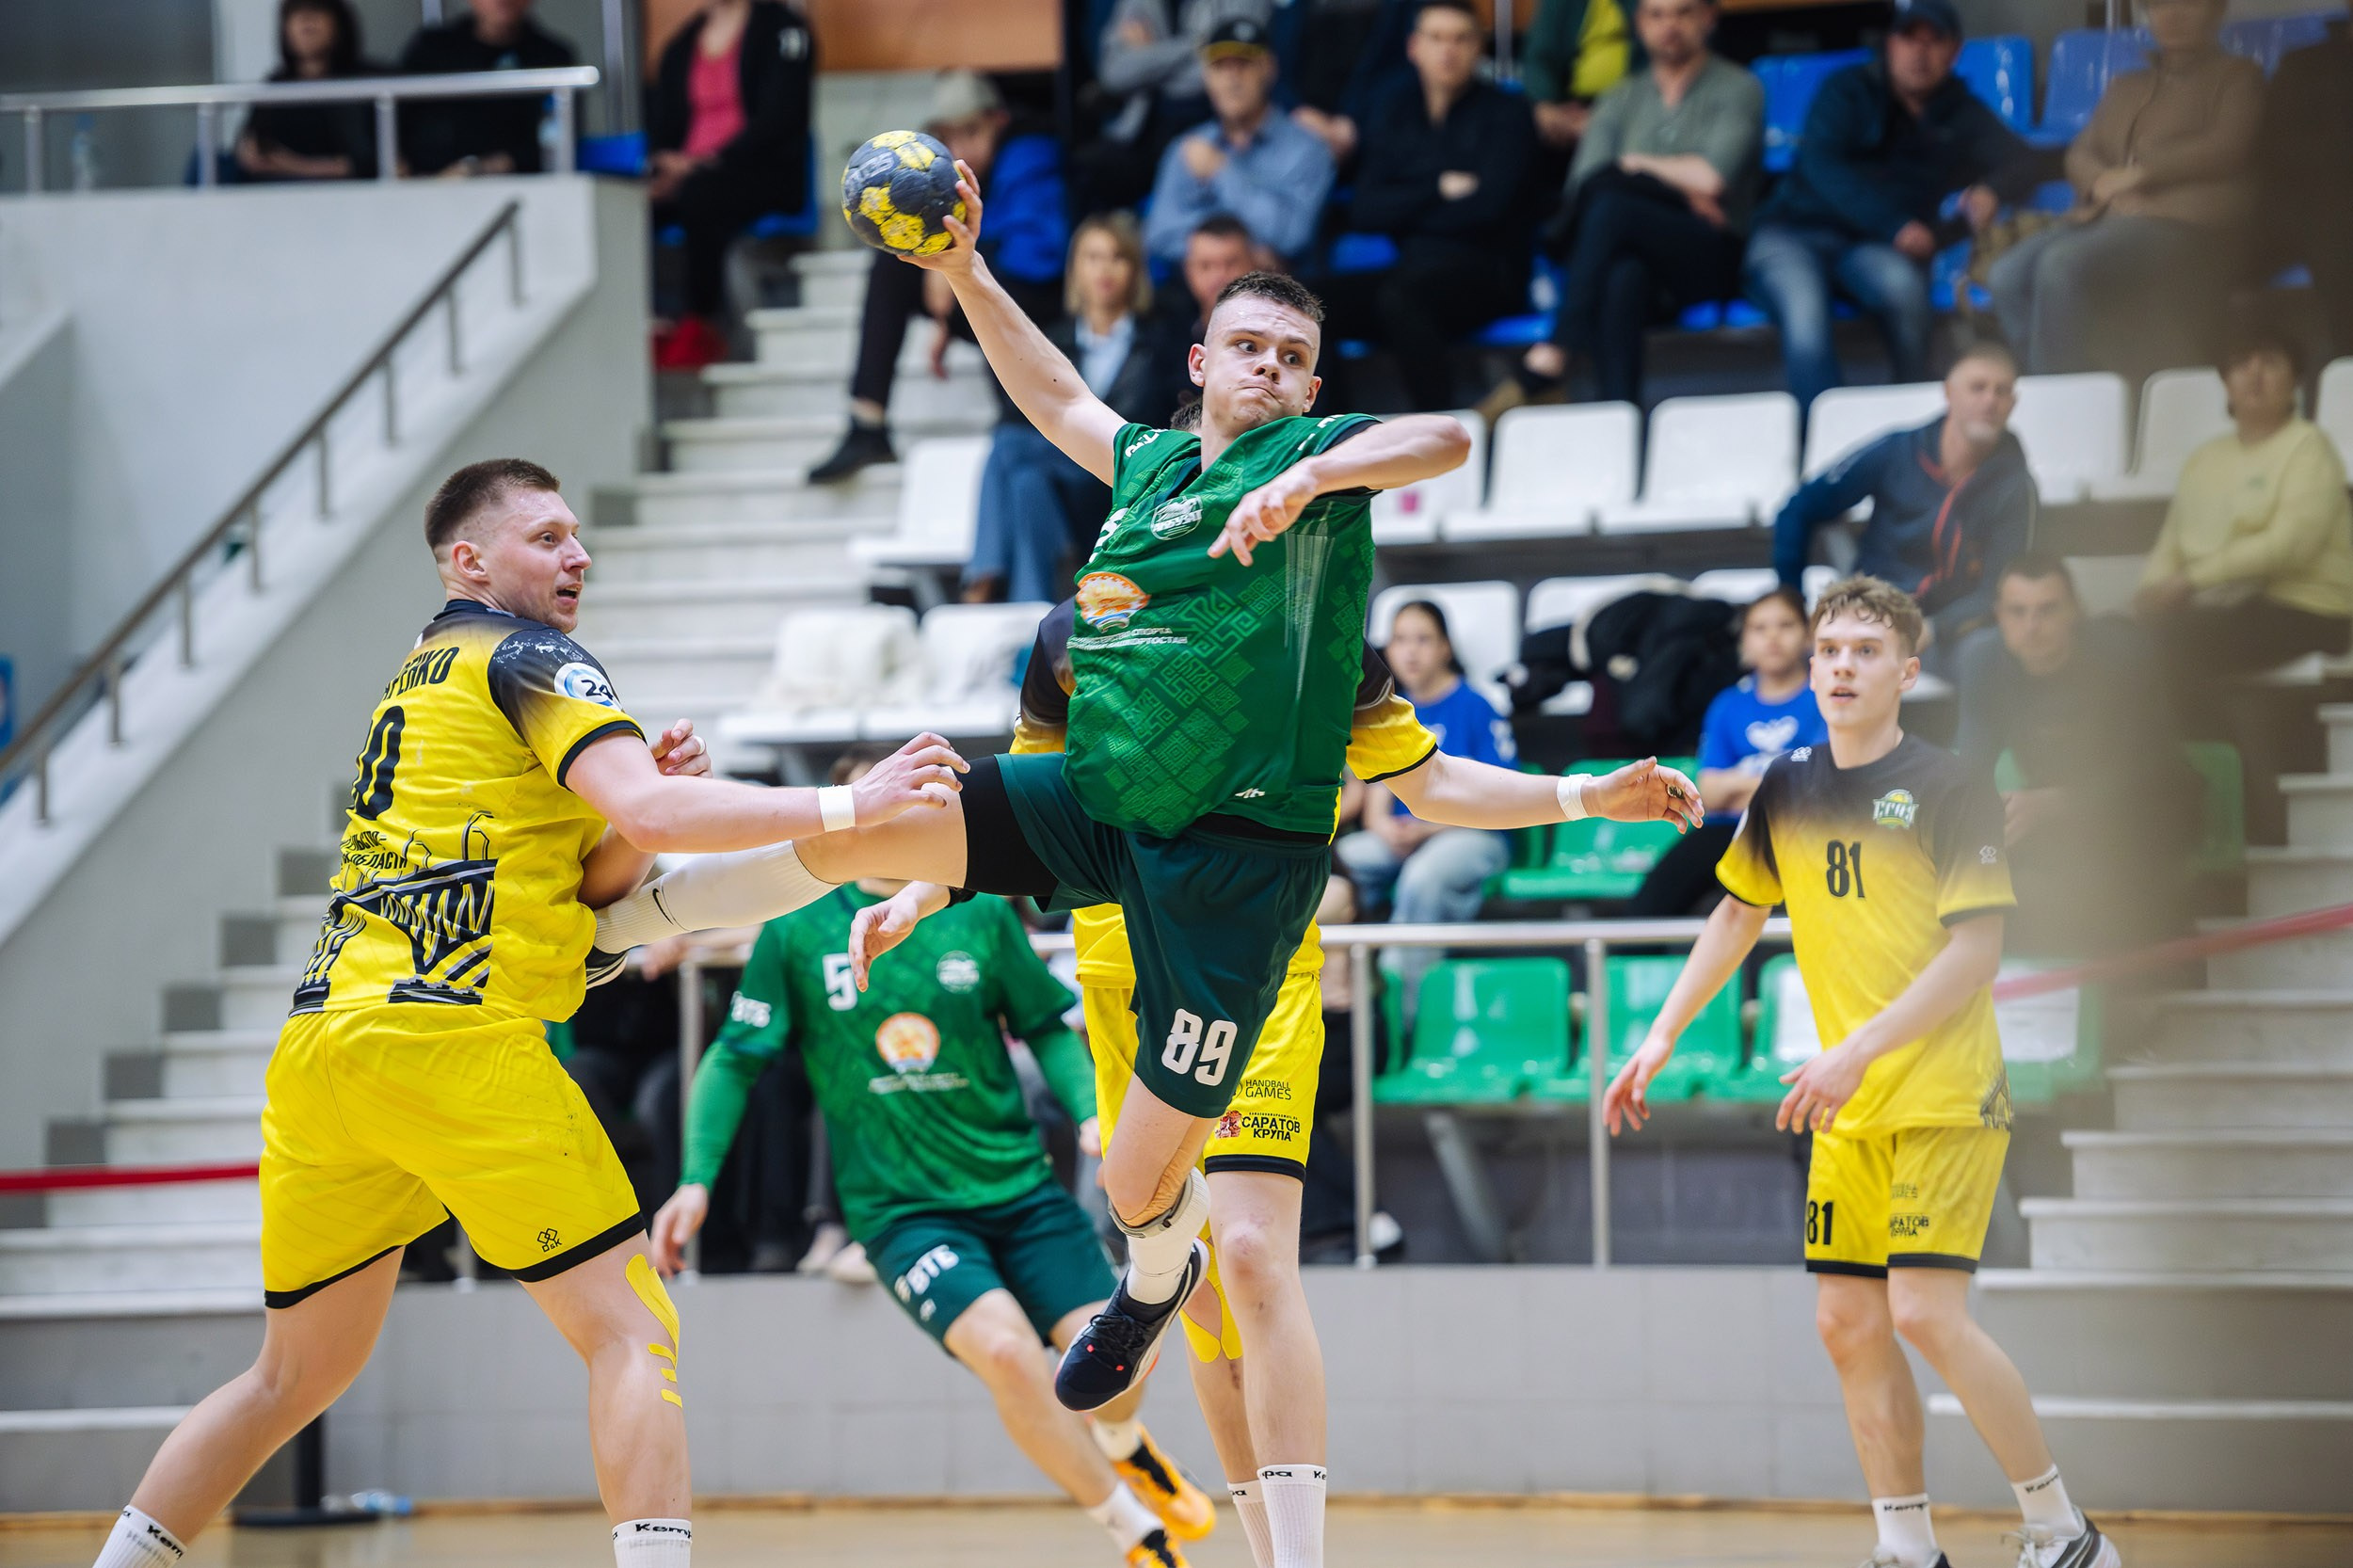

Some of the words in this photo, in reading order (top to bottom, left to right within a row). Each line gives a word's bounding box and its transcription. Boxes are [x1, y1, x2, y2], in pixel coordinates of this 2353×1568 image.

[1826, 839, 1866, 899] 81
[1160, 1007, 1239, 1087] 89
[1245, 1079, 1291, 1090] HANDBALL
[1245, 1086, 1292, 1101] GAMES
[1241, 1115, 1301, 1134] САРАТОВ
[1253, 1128, 1292, 1143] КРУПА
[1806, 1200, 1834, 1246] 81
